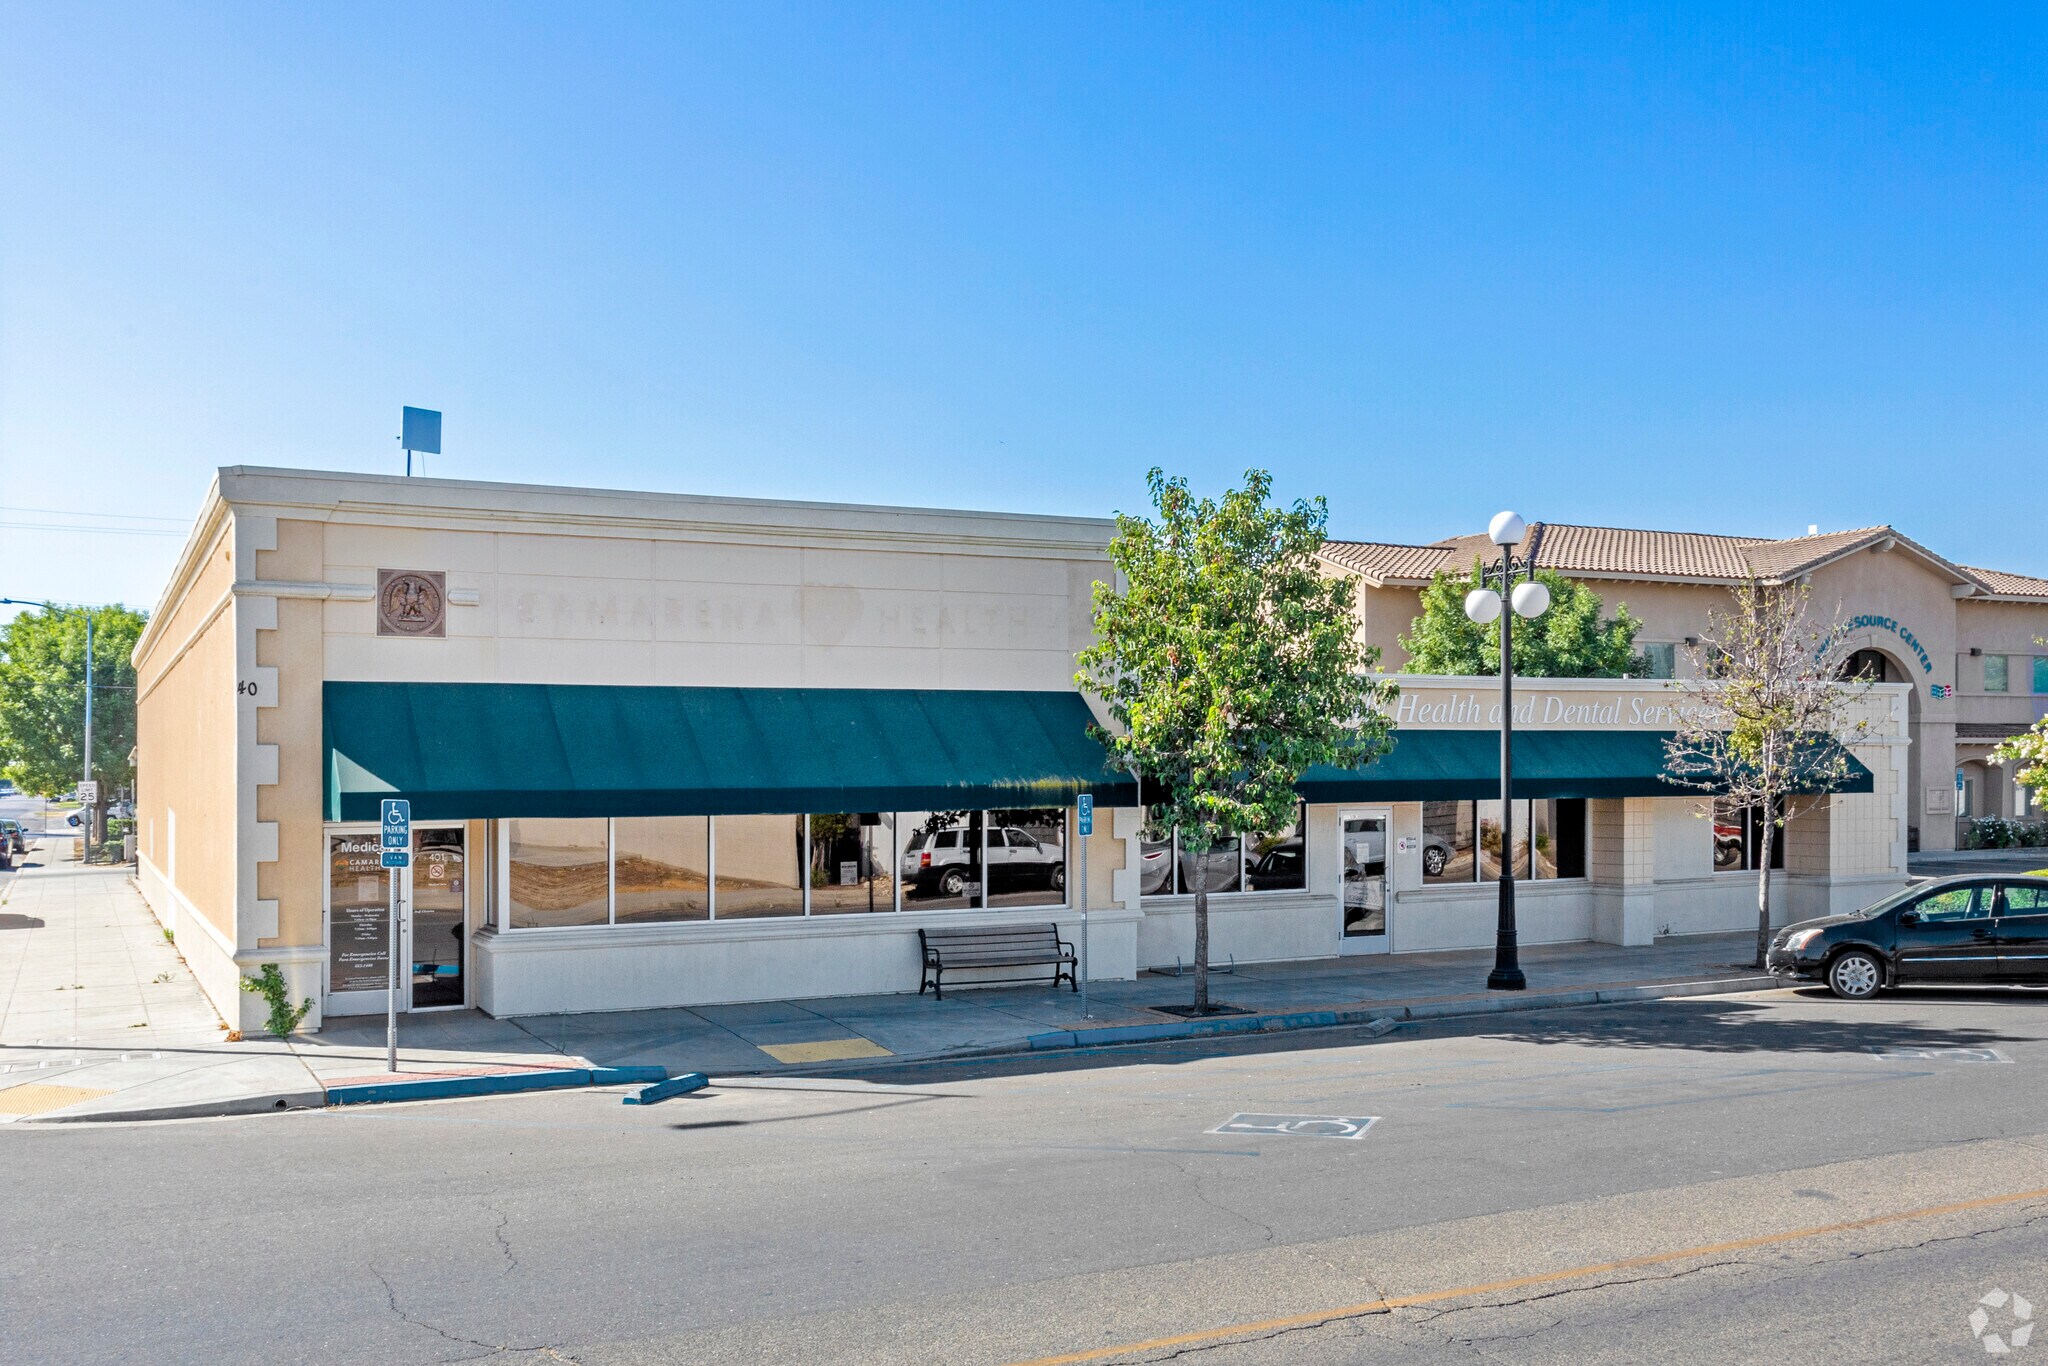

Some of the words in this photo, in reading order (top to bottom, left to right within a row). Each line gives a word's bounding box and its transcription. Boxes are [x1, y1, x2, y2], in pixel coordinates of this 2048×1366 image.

[1900, 627, 1933, 674] CENTER
[1395, 694, 1480, 724] Health
[1542, 697, 1621, 724] Dental
[383, 825, 408, 835] PARKING
[387, 837, 404, 846] ONLY
[429, 853, 445, 861] 401
